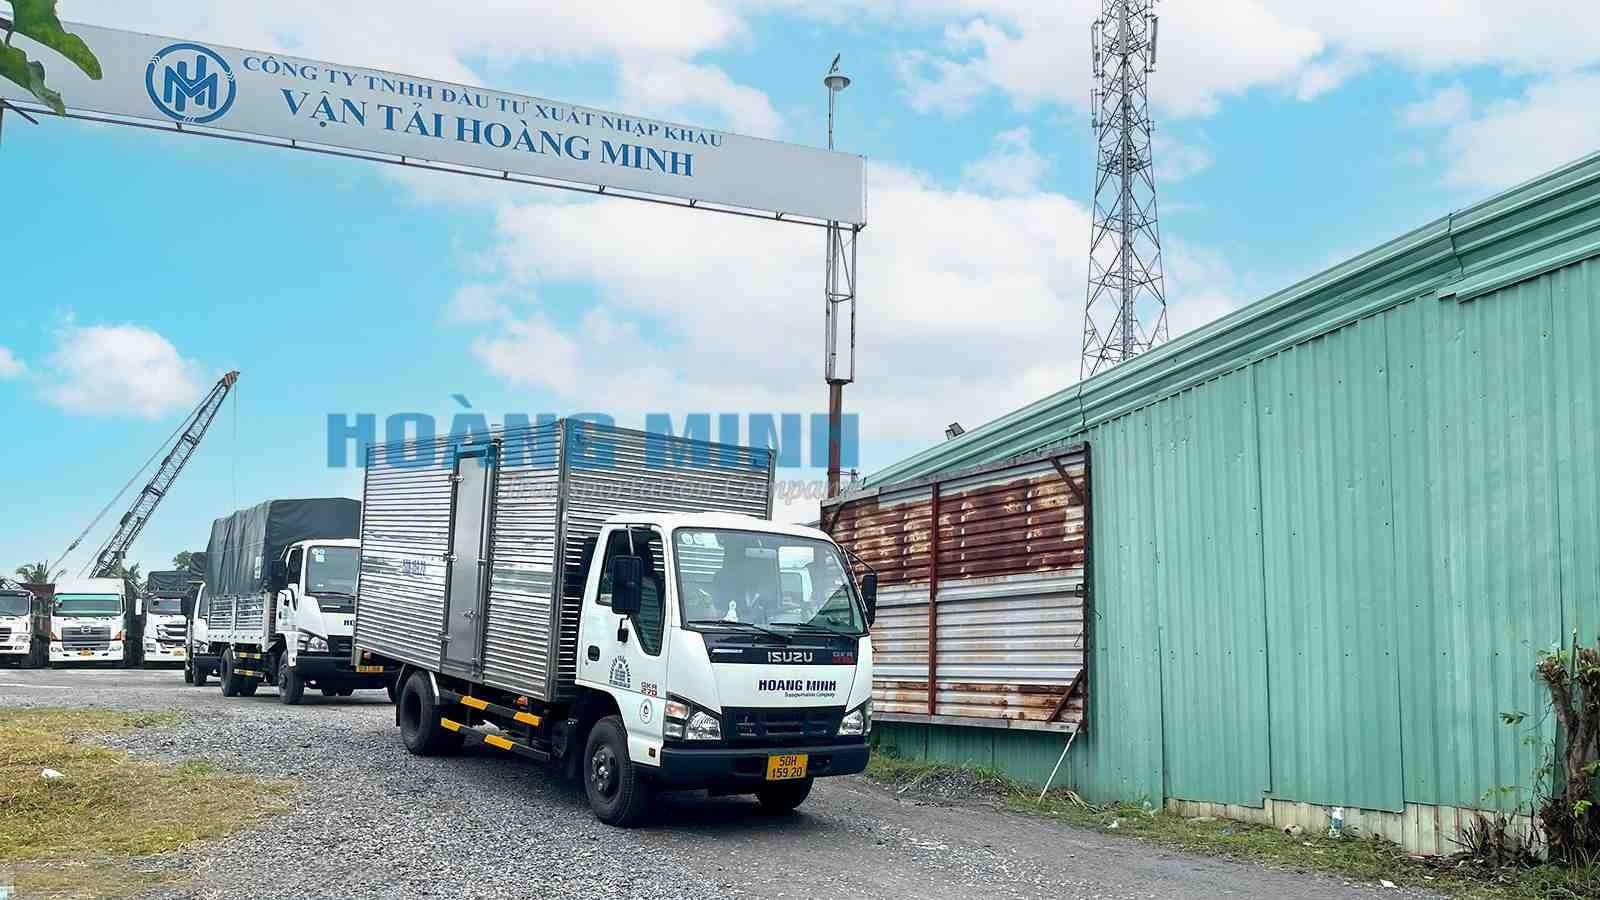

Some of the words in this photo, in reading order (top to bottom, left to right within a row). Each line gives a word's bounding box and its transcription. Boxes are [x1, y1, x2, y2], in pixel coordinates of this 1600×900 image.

[243, 55, 318, 81] CÔNG
[325, 68, 358, 87] TY
[364, 75, 433, 99] TNHH
[496, 97, 530, 114] TƯ
[281, 88, 368, 128] VẬN
[377, 102, 445, 139] TẢI
[455, 116, 592, 162] HOÀNG
[600, 140, 694, 177] MINH
[767, 651, 814, 663] ISUZU
[806, 680, 837, 691] MINH
[778, 755, 798, 767] 50H
